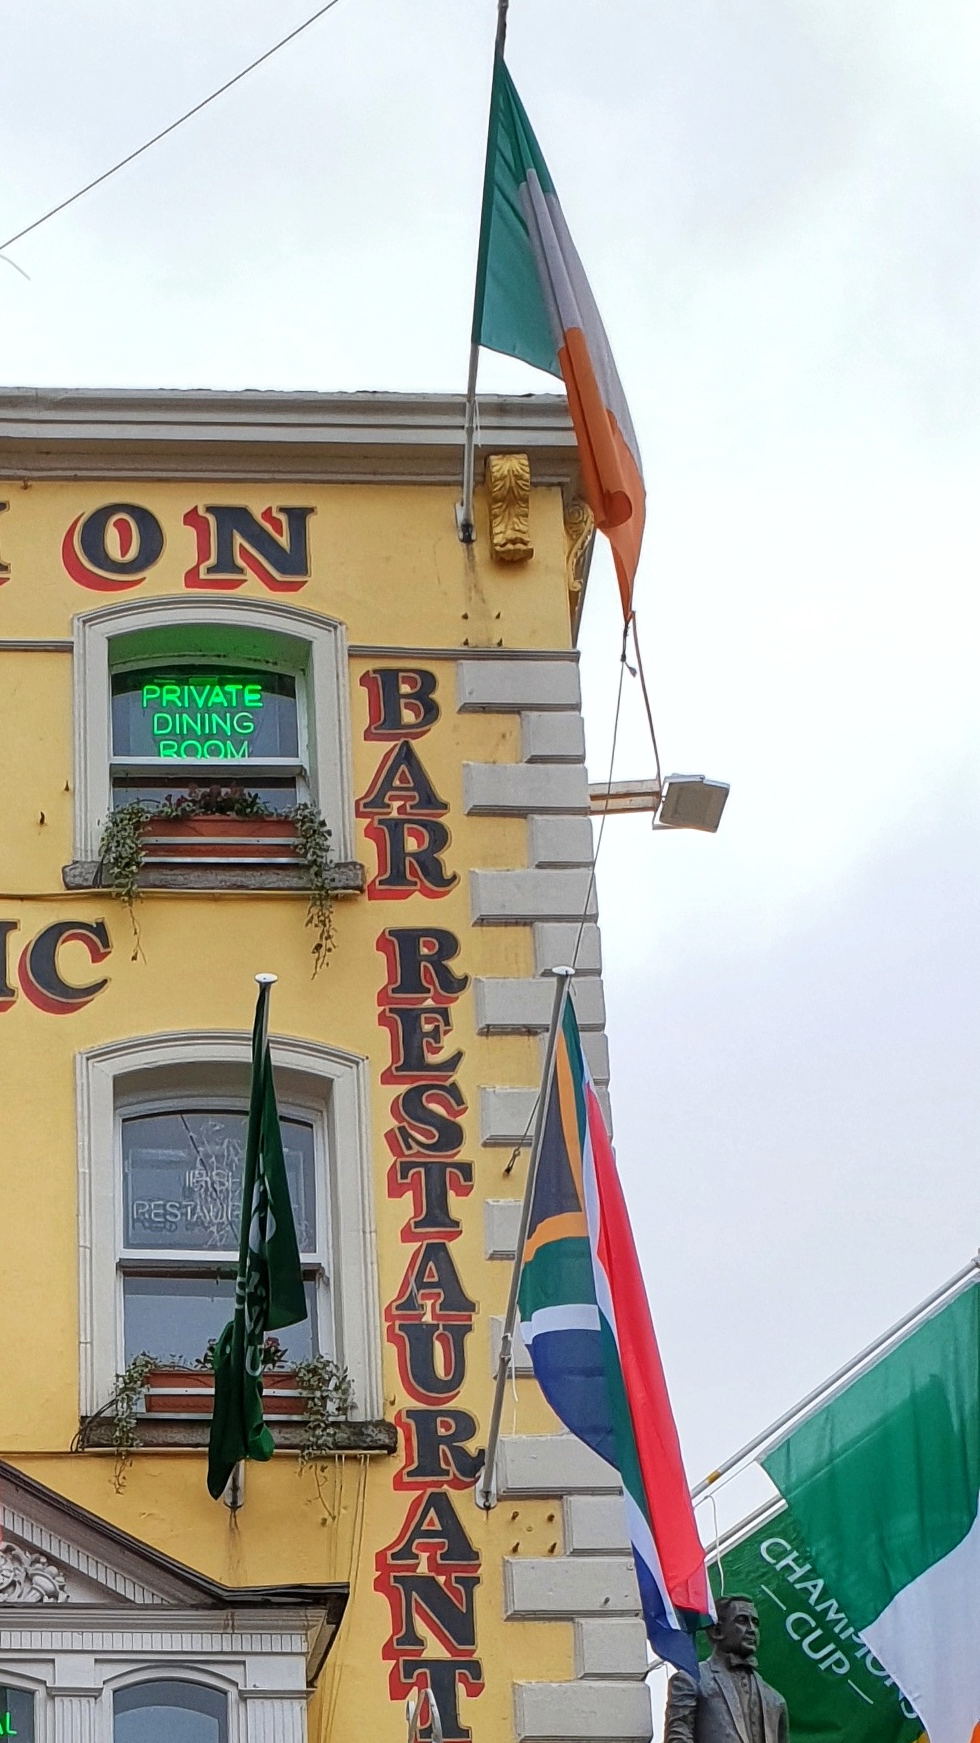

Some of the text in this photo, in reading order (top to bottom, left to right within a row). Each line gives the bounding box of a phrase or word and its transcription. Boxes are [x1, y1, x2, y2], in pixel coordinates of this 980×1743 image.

[142, 683, 264, 709] PRIVATE
[152, 711, 255, 737] DINING
[158, 739, 251, 759] ROOM
[356, 667, 461, 900] BAR
[785, 1611, 851, 1676] CUP
